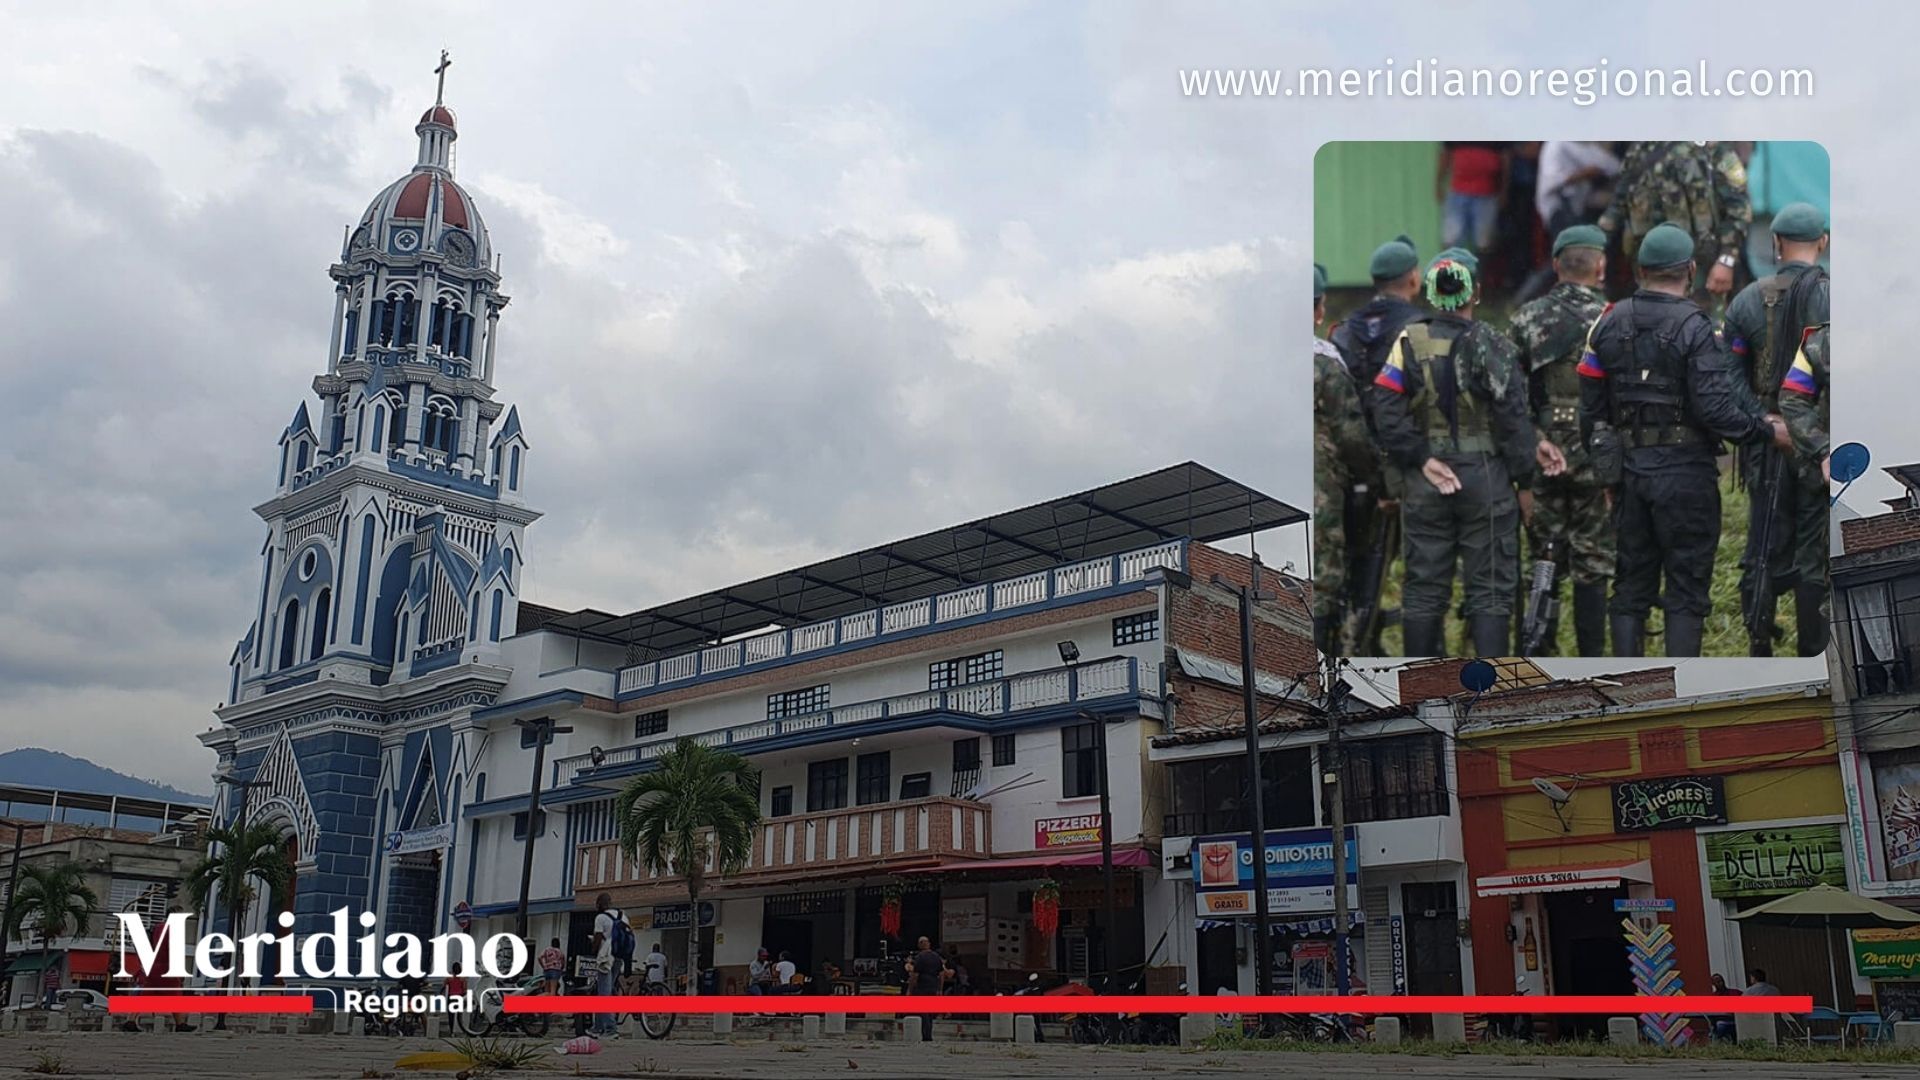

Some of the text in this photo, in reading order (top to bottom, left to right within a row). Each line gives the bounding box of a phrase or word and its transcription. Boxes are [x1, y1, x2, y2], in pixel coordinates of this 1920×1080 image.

[1667, 801, 1707, 817] PAVA
[1037, 815, 1103, 832] PIZZERIA
[1723, 844, 1826, 880] BELLAU
[1214, 899, 1243, 909] GRATIS
[654, 909, 692, 924] PRADER
